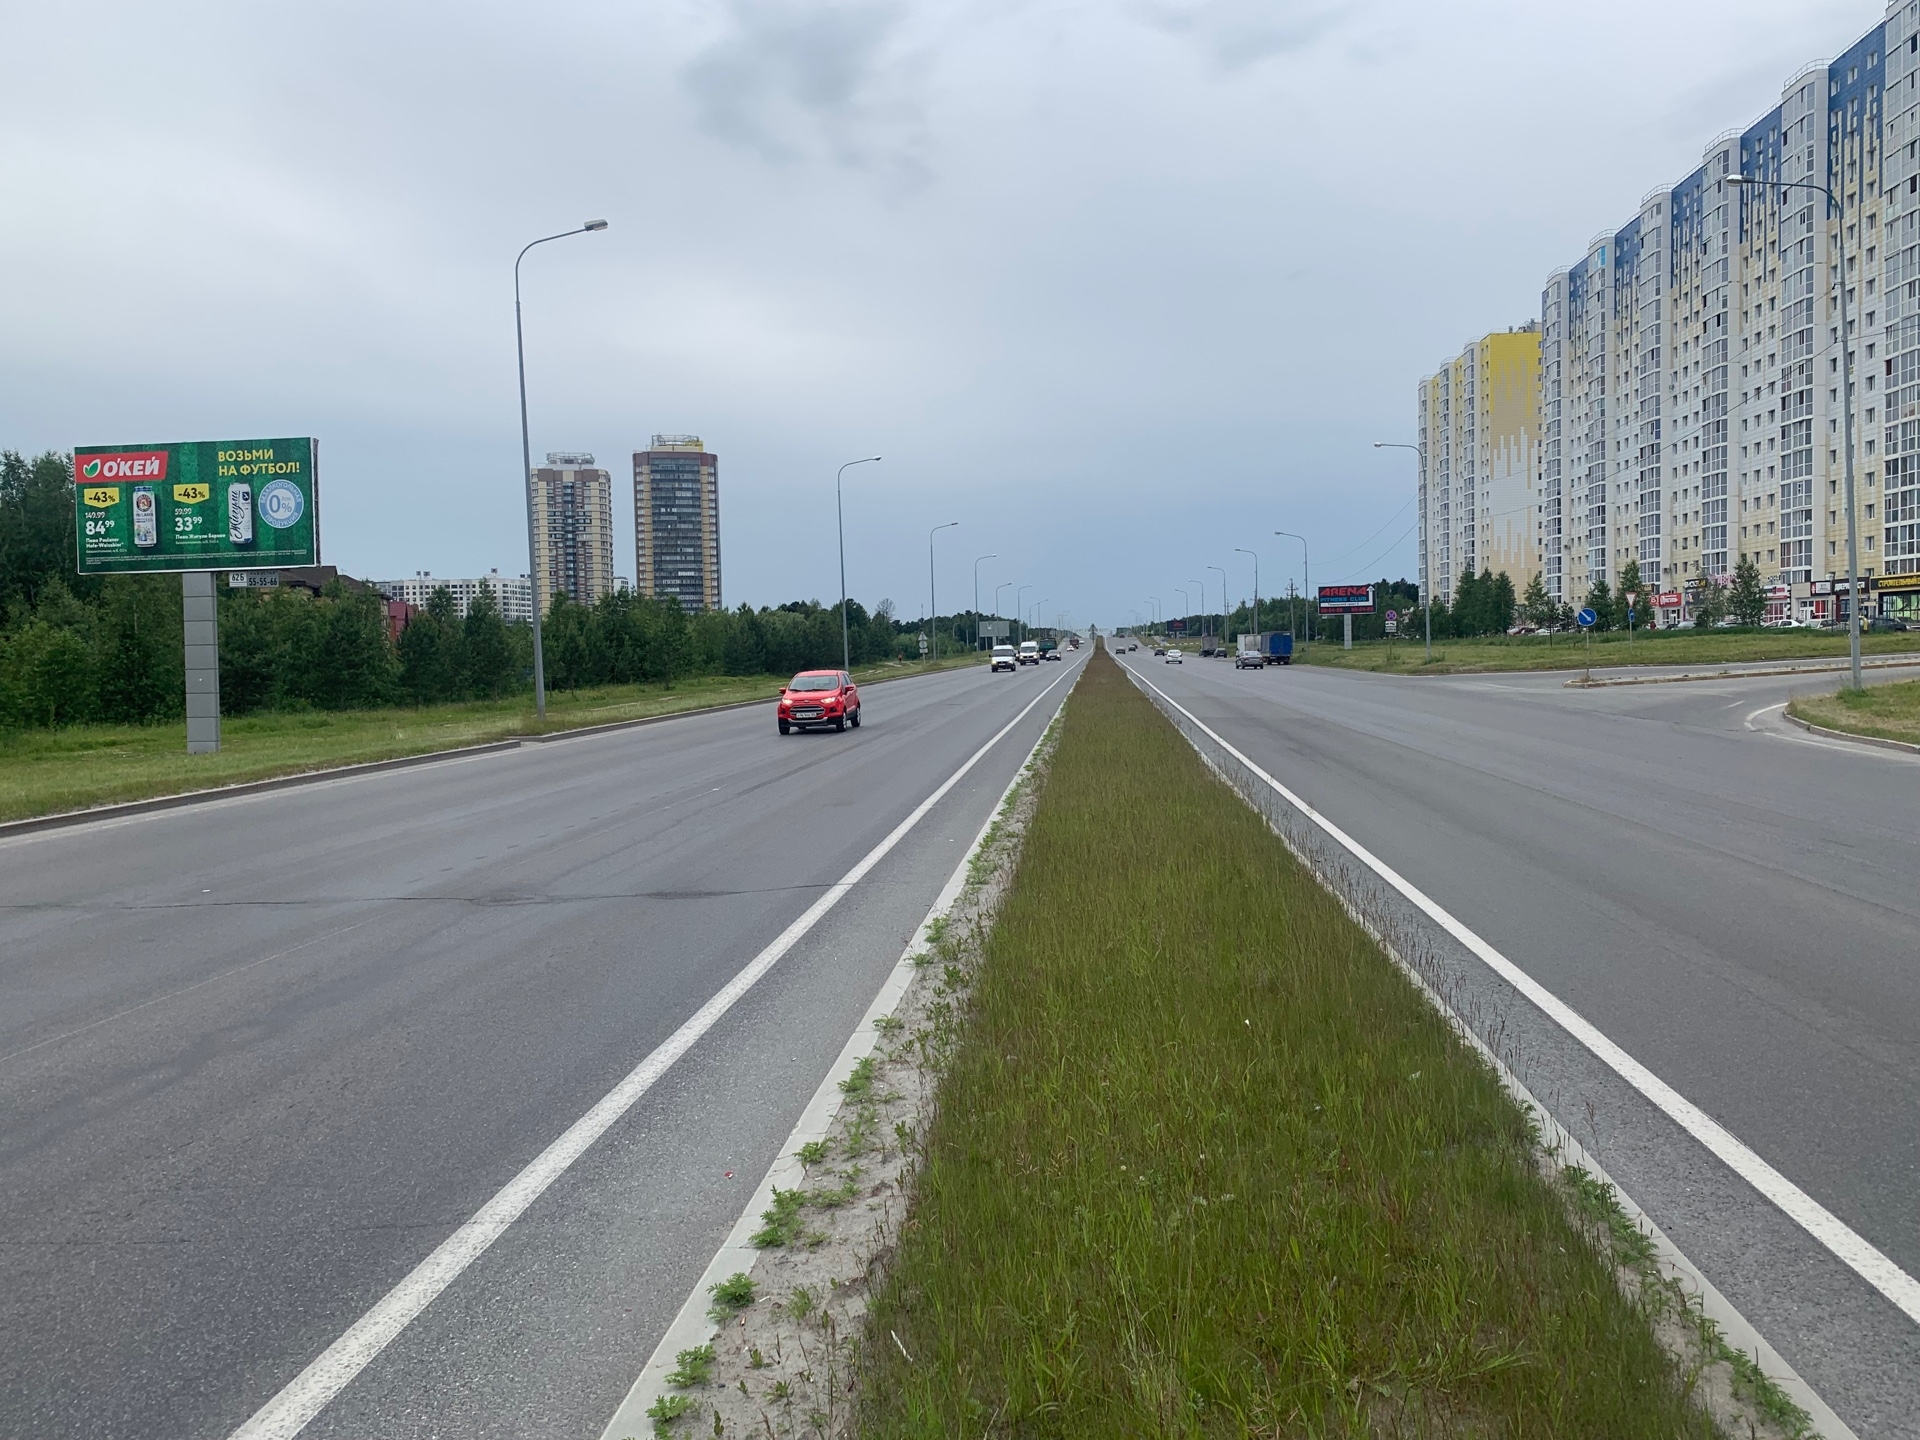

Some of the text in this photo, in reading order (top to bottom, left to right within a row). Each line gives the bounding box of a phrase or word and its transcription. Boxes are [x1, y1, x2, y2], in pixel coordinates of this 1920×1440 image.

[218, 449, 274, 462] ВОЗЬМИ
[219, 462, 300, 477] НА ФУТБОЛ!
[88, 491, 116, 503] -43%
[178, 487, 206, 499] -43%
[265, 512, 299, 527] ПРОДУКЦИЯ
[248, 577, 278, 586] 55-55-66
[1320, 587, 1367, 596] ARENA
